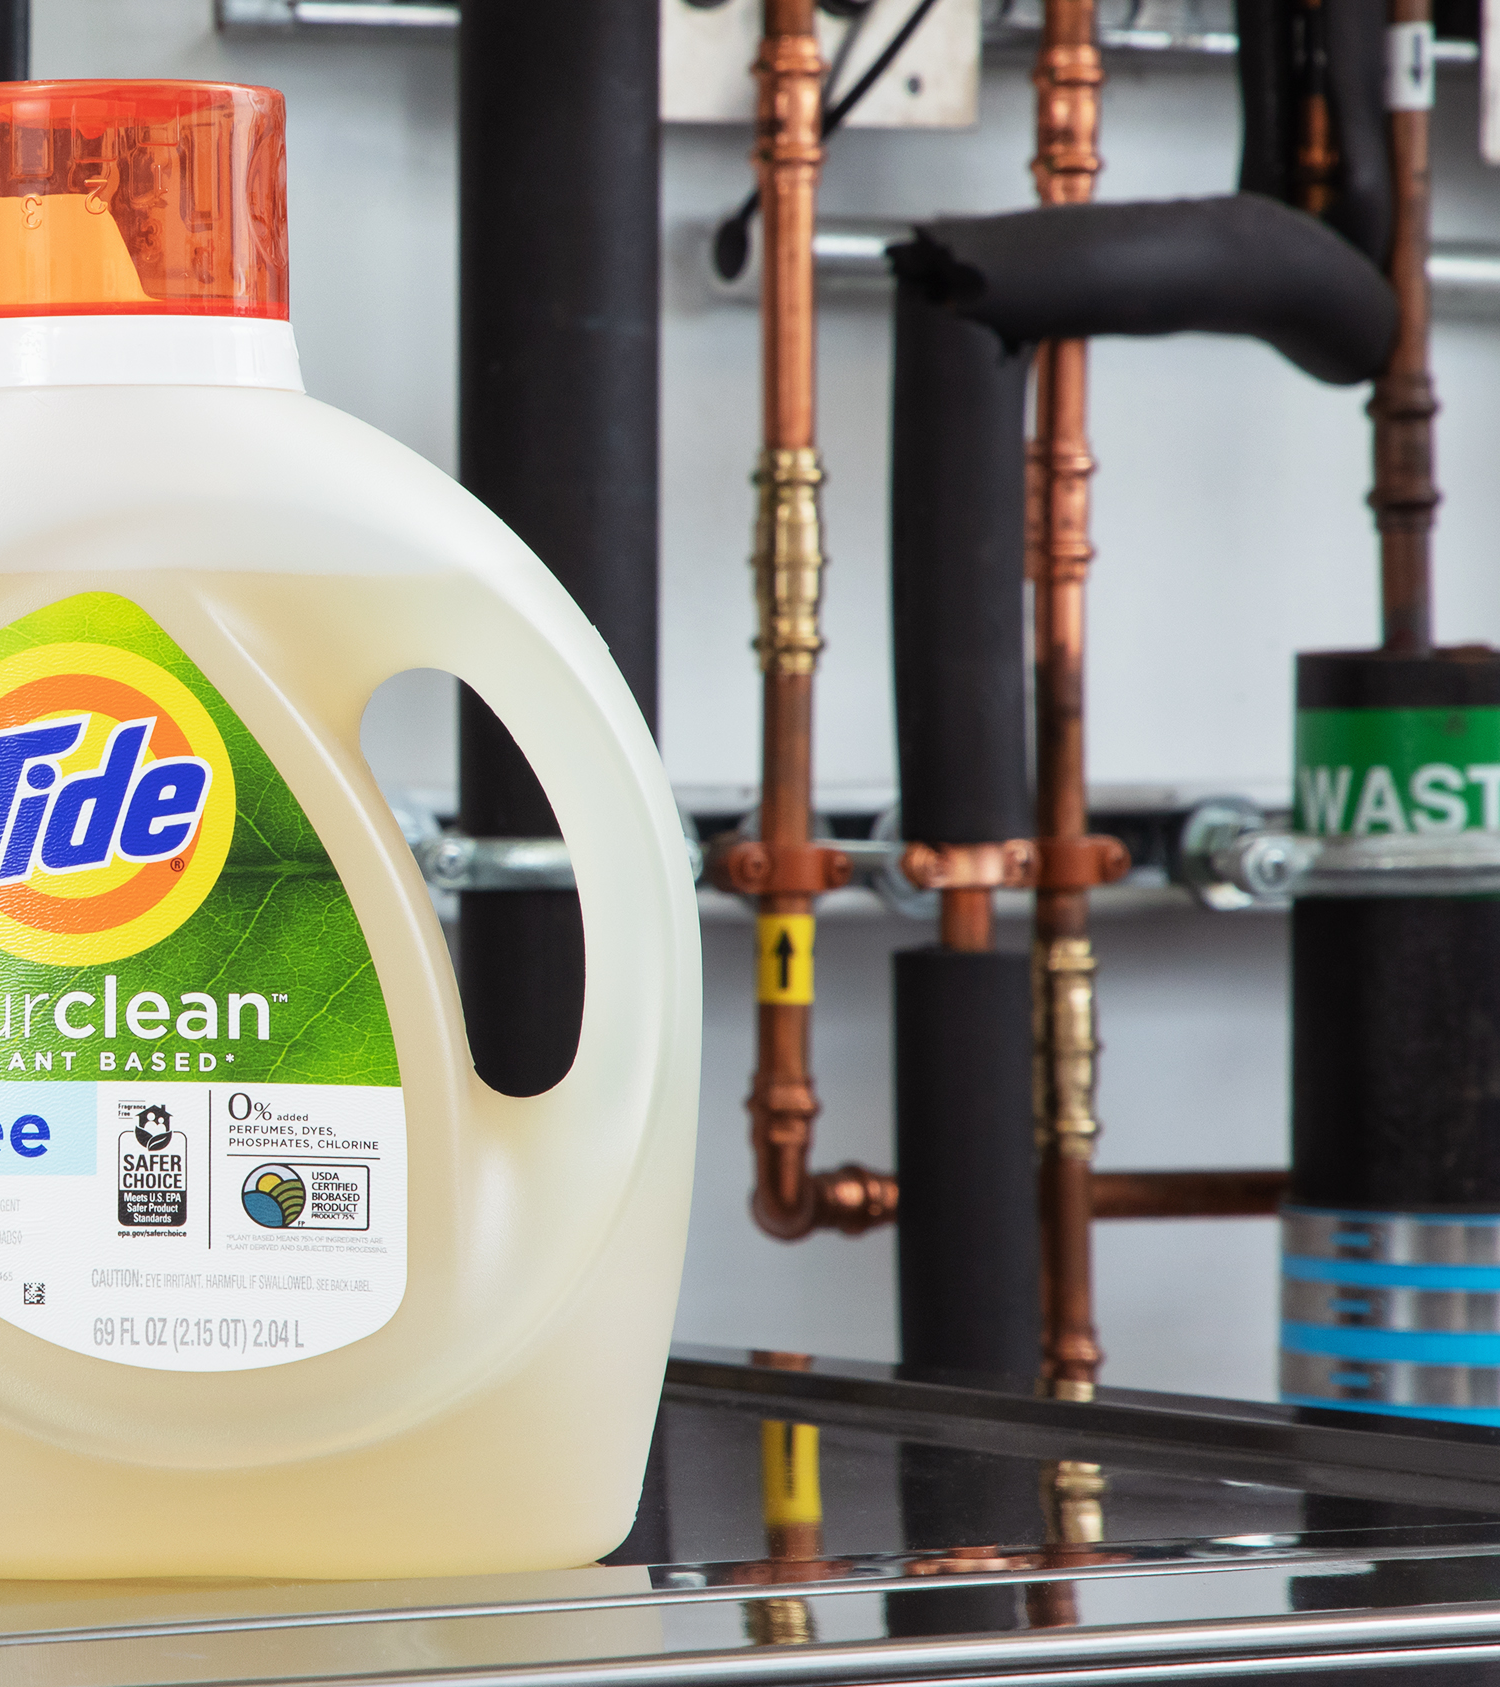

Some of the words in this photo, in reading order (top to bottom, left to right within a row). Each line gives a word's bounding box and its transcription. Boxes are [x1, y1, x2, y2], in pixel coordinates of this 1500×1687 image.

[228, 1092, 272, 1121] 0%
[277, 1113, 309, 1122] added
[229, 1125, 298, 1136] PERFUMES,
[302, 1126, 337, 1137] DYES,
[229, 1138, 313, 1149] PHOSPHATES,
[317, 1139, 379, 1150] CHLORINE
[123, 1154, 182, 1172] SAFER
[123, 1173, 182, 1189] CHOICE
[311, 1171, 340, 1181] USDA
[311, 1182, 358, 1191] CERTIFIED
[124, 1192, 148, 1202] Meets
[150, 1193, 164, 1202] U.S.
[166, 1193, 181, 1202] EPA
[311, 1192, 360, 1202] BIOBASED
[127, 1203, 147, 1213] Safer
[149, 1203, 178, 1213] Product
[311, 1203, 358, 1212] PRODUCT
[133, 1213, 172, 1223] Standards
[118, 1229, 187, 1238] epa.gov/saferchoice
[91, 1268, 143, 1288] CAUTION:
[146, 1274, 161, 1288] EYE
[163, 1274, 204, 1288] IRRITANT.
[206, 1274, 247, 1289] HARMFUL
[249, 1275, 256, 1289] IF
[259, 1275, 314, 1290] SWALLOWED.
[316, 1279, 329, 1291] SEE
[331, 1279, 349, 1291] BACK
[93, 1317, 115, 1346] 69
[120, 1317, 140, 1346] FL
[145, 1317, 167, 1346] OZ
[173, 1317, 213, 1353] (2.15
[219, 1318, 247, 1354] QT)
[252, 1319, 289, 1348] 2.04
[295, 1320, 304, 1347] L
